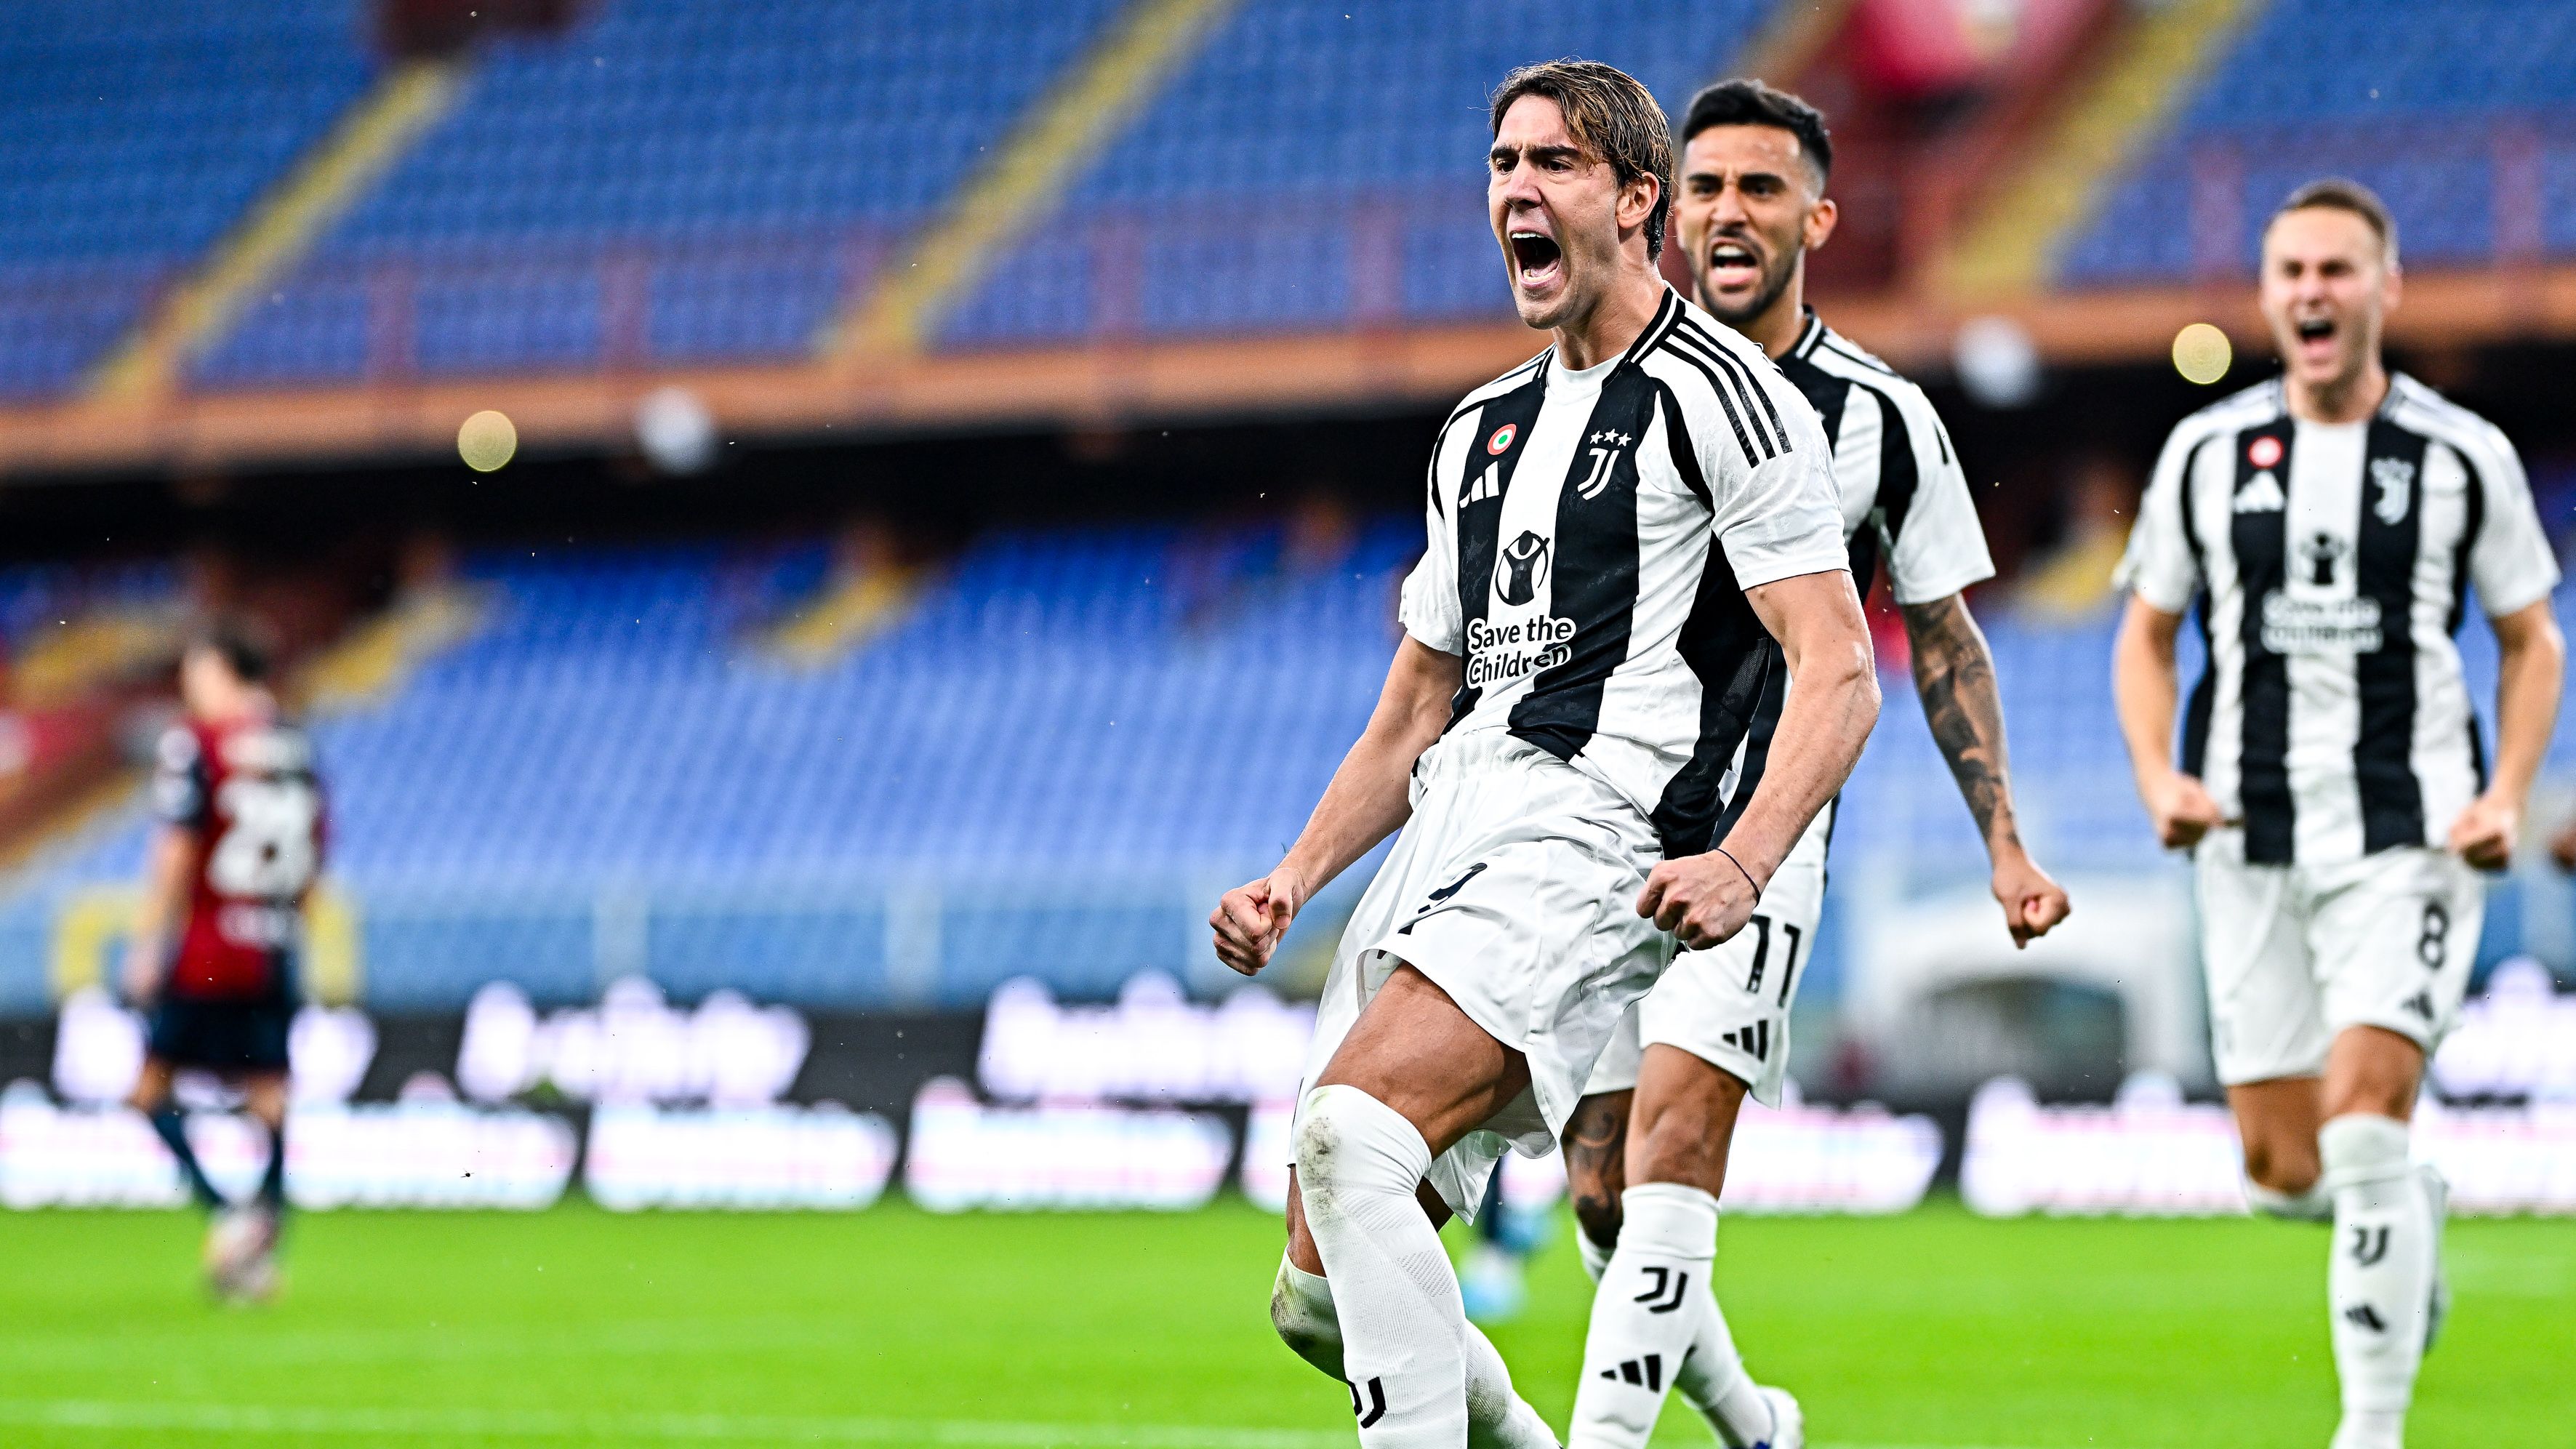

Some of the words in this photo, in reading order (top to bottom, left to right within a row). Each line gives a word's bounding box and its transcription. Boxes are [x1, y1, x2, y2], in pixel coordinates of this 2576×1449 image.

[1470, 622, 1520, 649] Save
[1526, 615, 1572, 641] the
[1469, 648, 1568, 684] Children
[1747, 914, 1801, 1008] 11
[2417, 901, 2449, 971] 8
